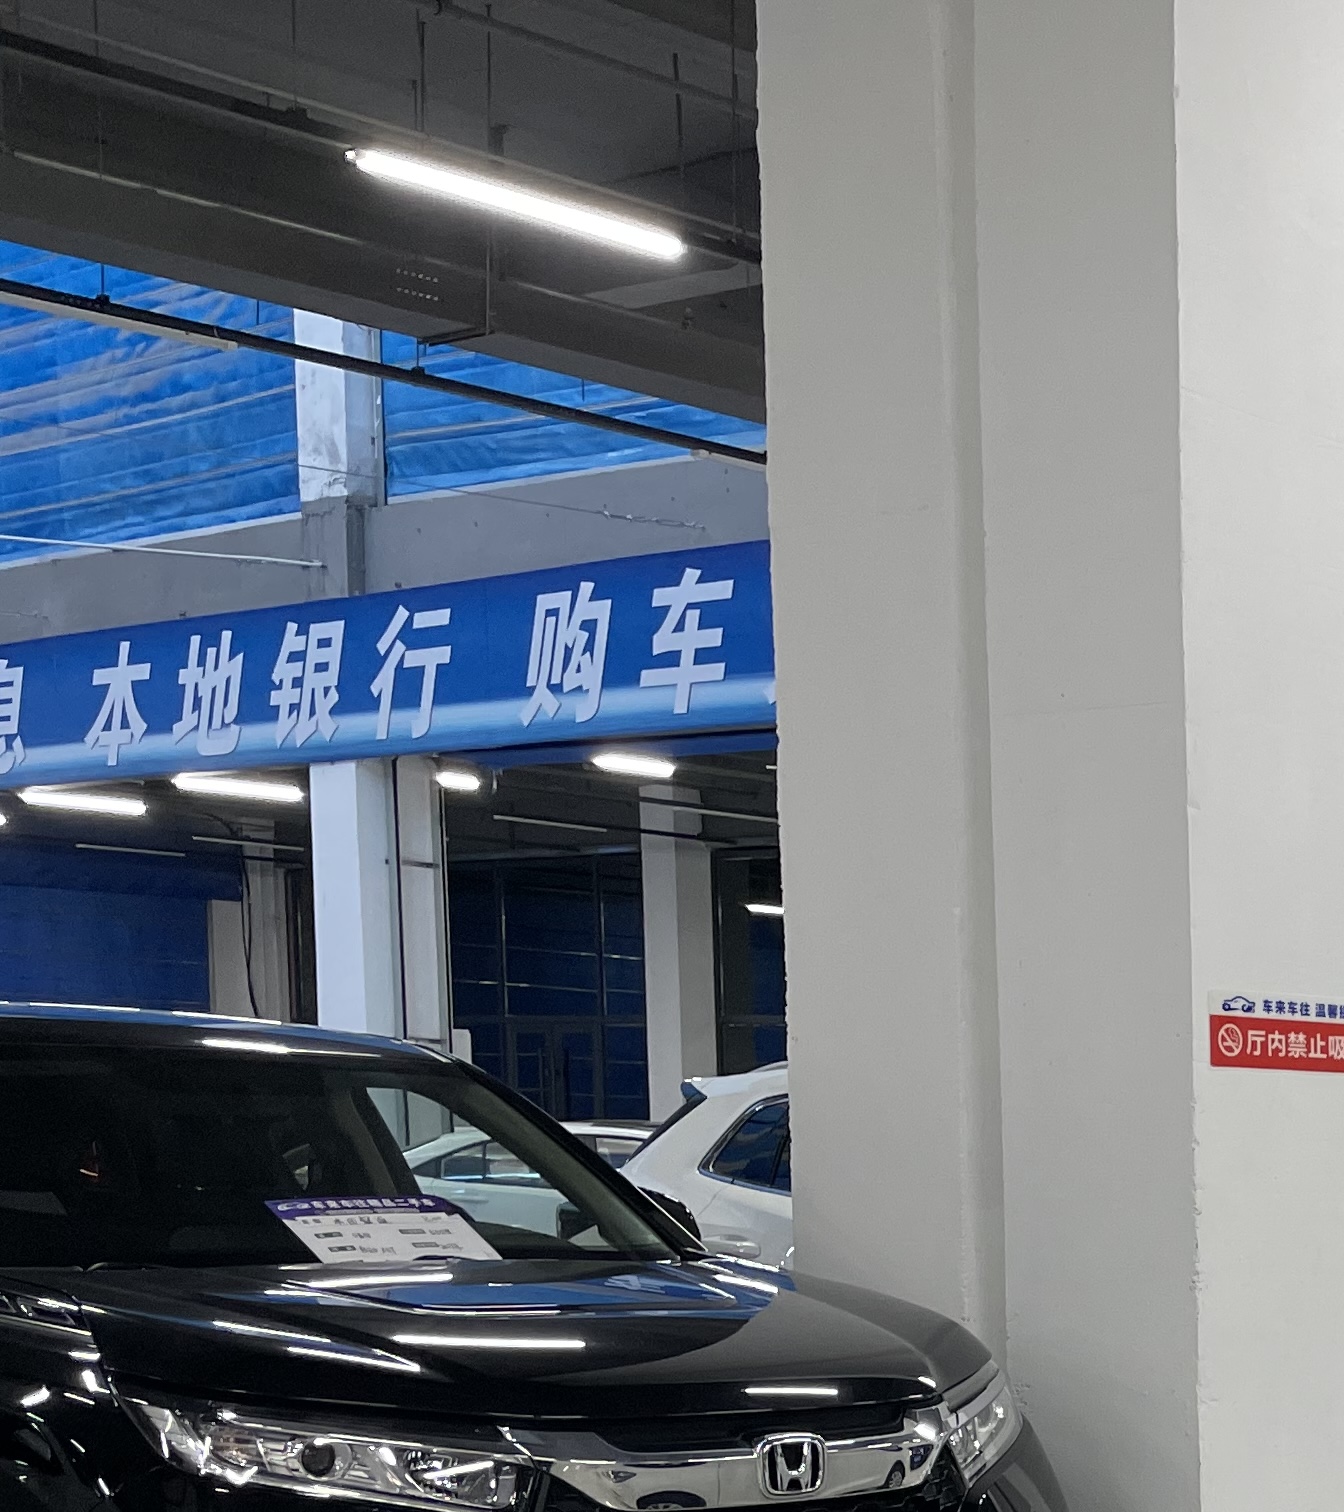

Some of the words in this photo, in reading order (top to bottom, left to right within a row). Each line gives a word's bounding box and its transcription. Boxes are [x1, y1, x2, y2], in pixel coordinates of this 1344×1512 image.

[84, 604, 452, 767] 本地银行
[520, 567, 734, 727] 购车
[1262, 999, 1311, 1017] 车来车往
